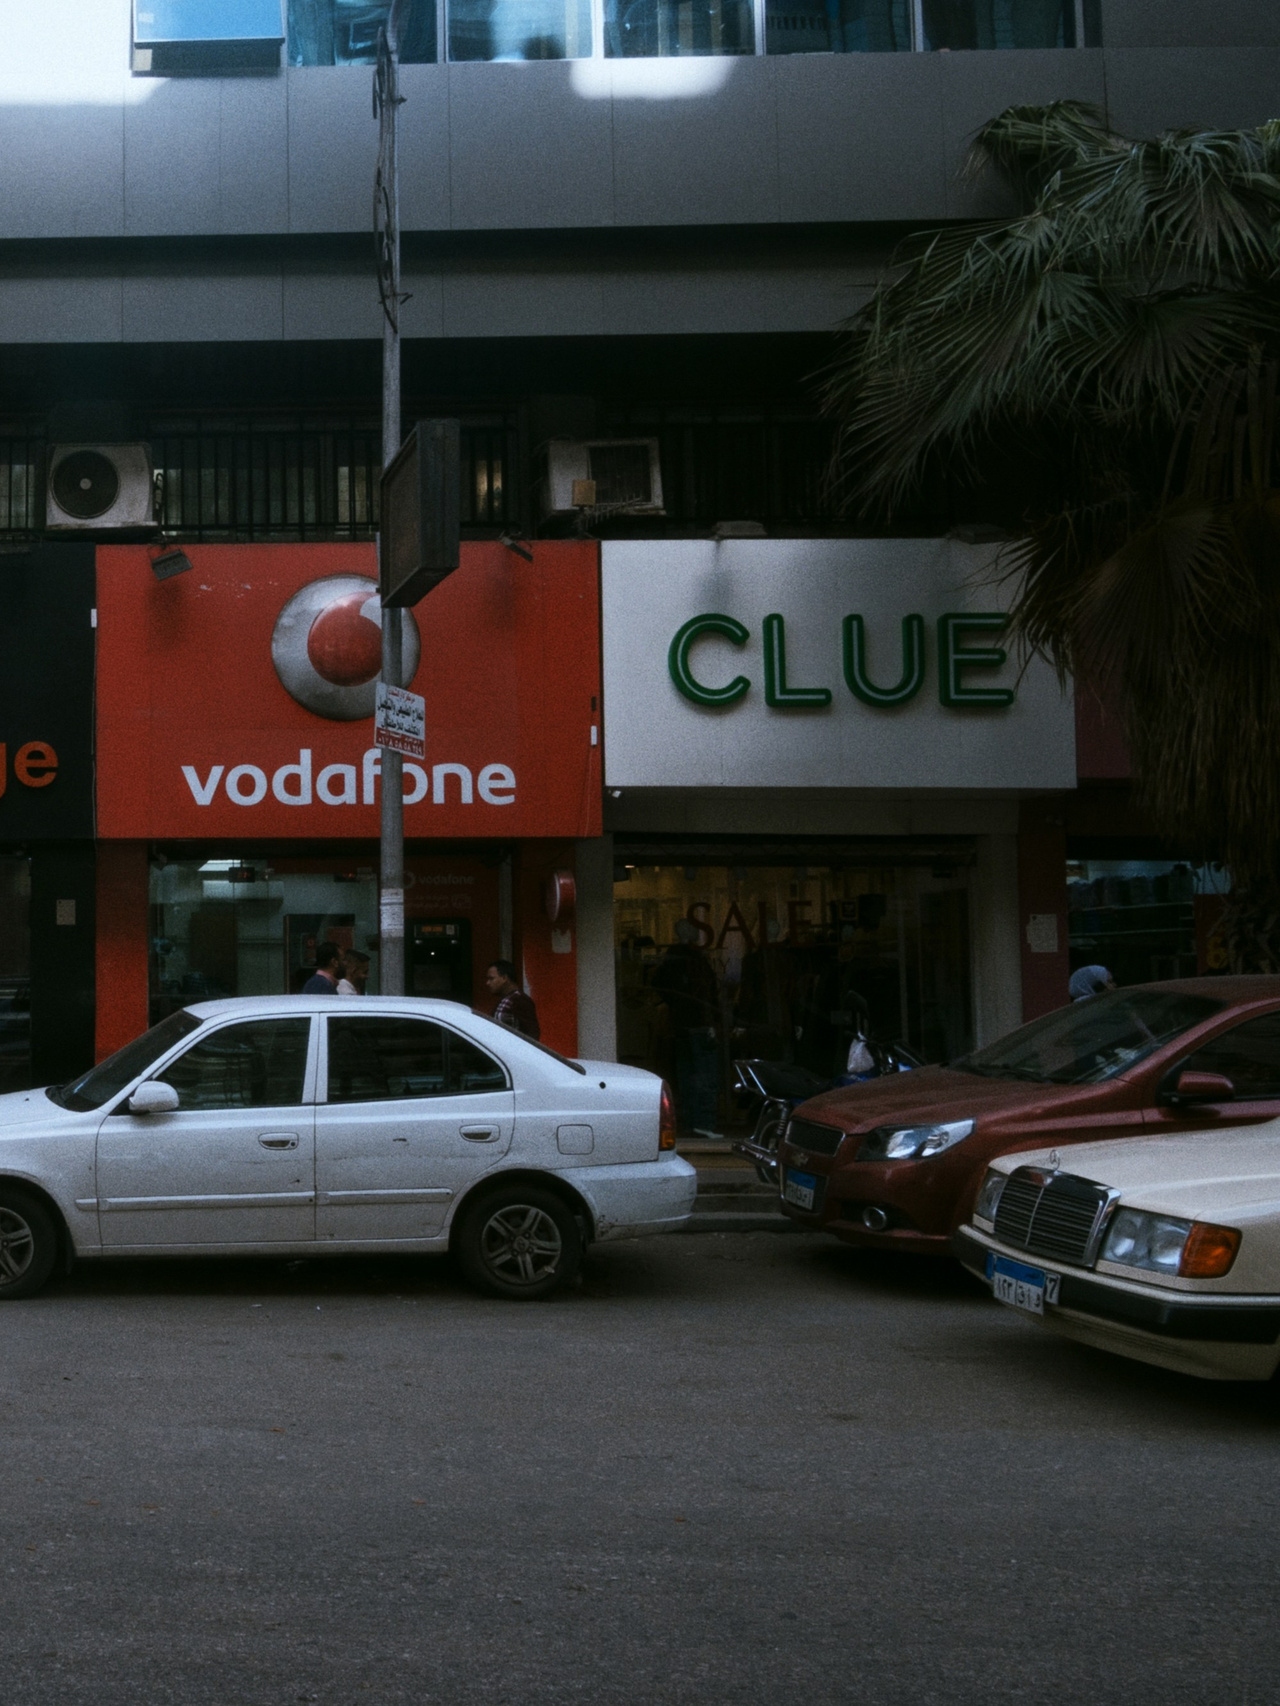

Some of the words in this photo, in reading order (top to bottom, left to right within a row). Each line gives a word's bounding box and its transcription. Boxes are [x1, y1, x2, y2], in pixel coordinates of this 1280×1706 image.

[667, 612, 1014, 707] CLUE
[181, 748, 517, 806] vodafone
[419, 873, 475, 886] vodafone
[685, 900, 813, 950] SALE
